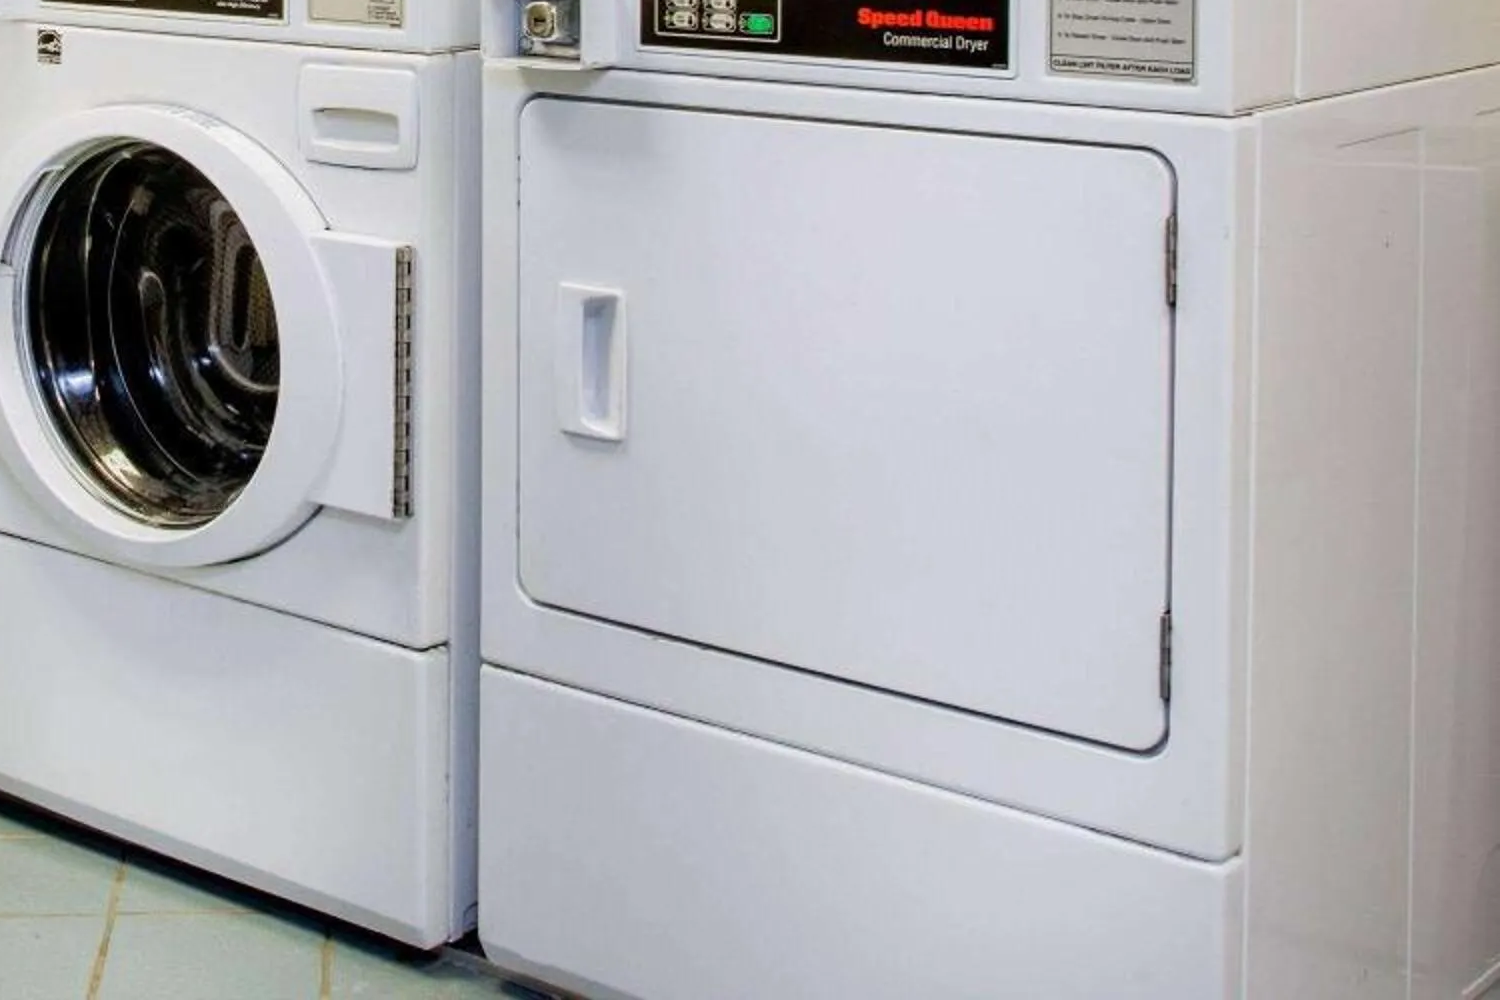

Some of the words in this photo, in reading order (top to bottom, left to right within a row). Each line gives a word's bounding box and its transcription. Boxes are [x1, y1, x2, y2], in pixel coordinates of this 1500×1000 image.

[857, 7, 923, 29] Speed
[925, 10, 995, 31] Queen
[883, 31, 953, 49] Commercial
[955, 36, 989, 53] Dryer
